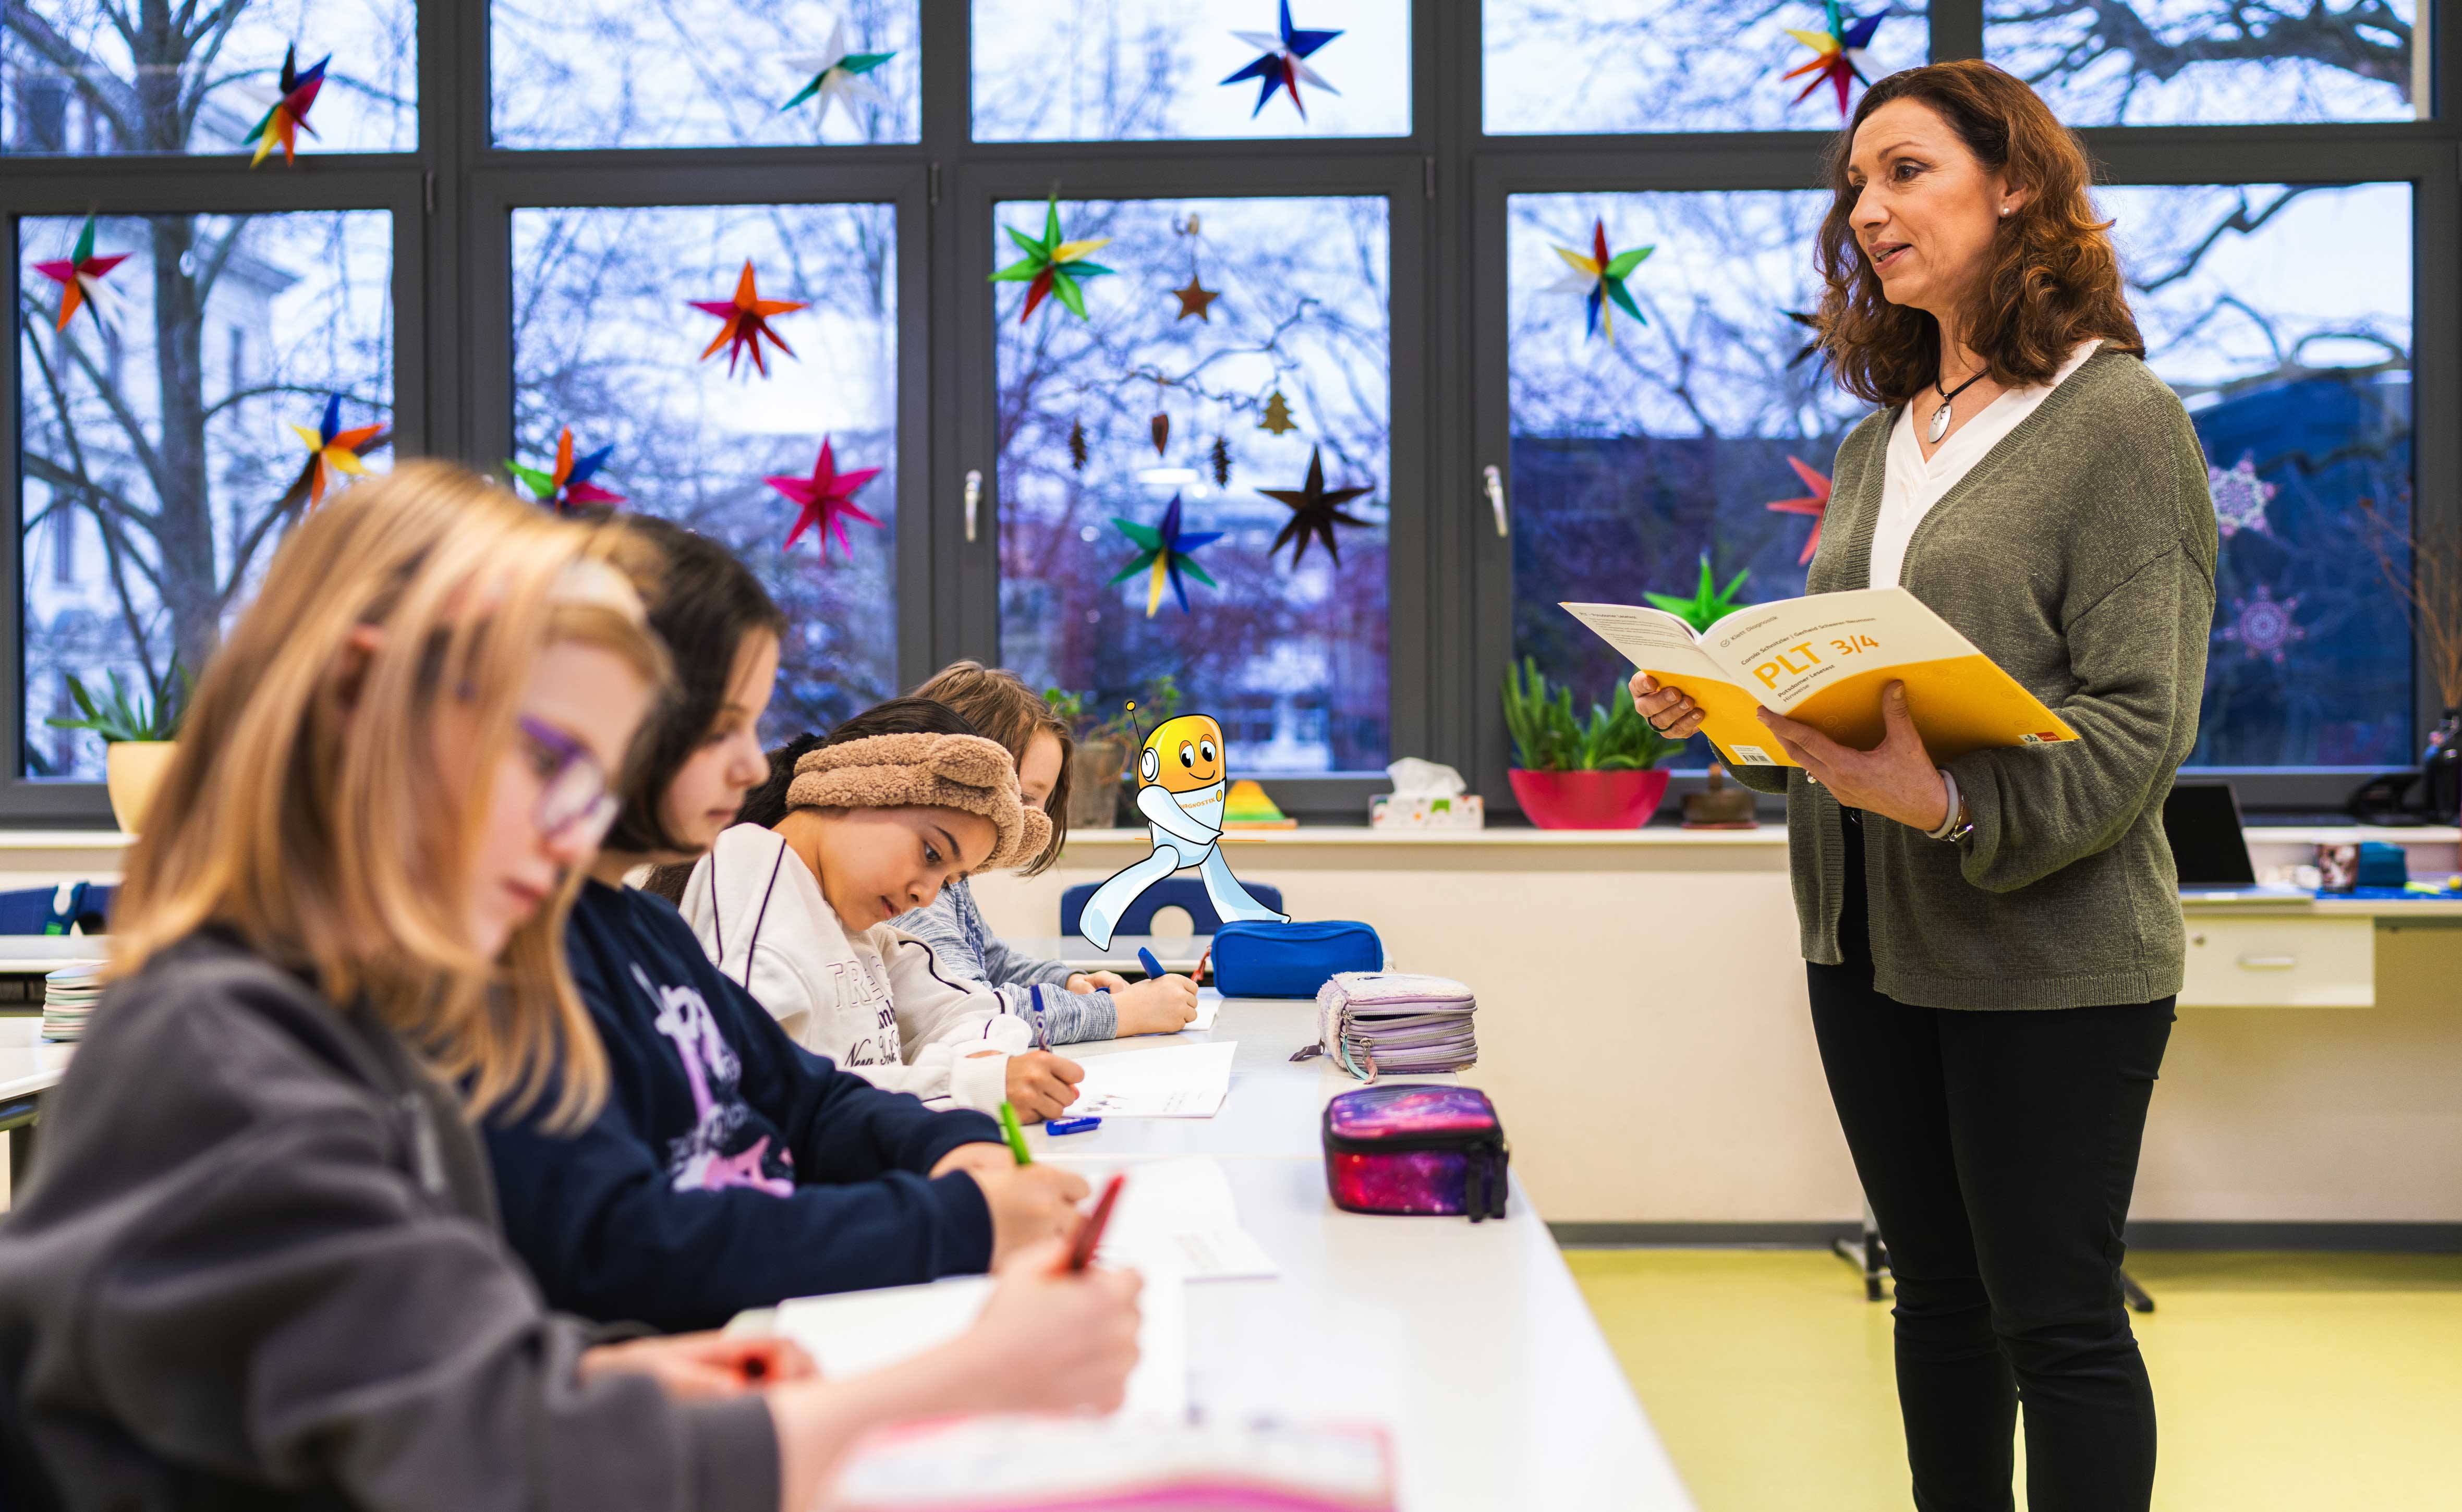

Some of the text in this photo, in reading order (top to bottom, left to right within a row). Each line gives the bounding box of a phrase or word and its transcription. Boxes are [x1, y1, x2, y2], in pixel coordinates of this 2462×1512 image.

[1730, 616, 1778, 641] Klett Diagnostik
[1741, 651, 1761, 665] Carola
[1760, 636, 1789, 653] Schnitzler
[1793, 626, 1818, 637] Gerheid
[1752, 635, 1879, 690] PLT 3/4
[1777, 664, 1836, 698] Potsdamer Lesetest
[1782, 684, 1810, 703] Hinweise
